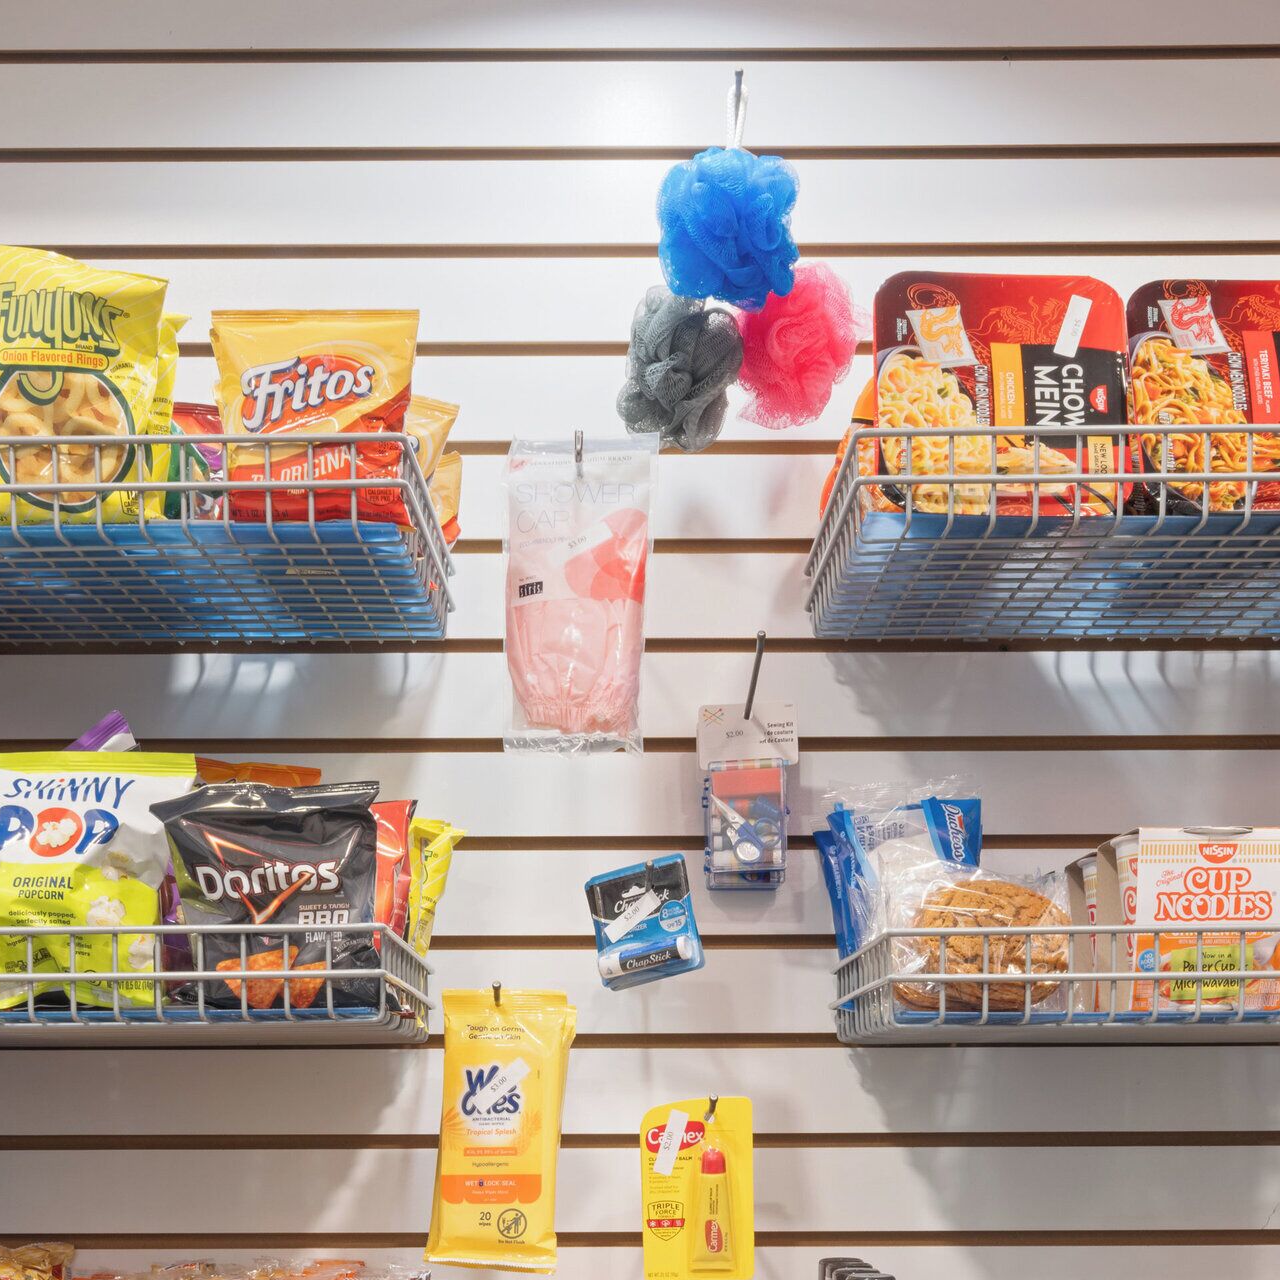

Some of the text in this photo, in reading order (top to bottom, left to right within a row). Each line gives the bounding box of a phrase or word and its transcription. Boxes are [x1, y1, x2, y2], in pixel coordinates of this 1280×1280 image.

[2, 349, 105, 368] Onion Flavored Rings
[242, 356, 376, 432] Fritos
[1033, 366, 1062, 427] MEIN
[1061, 364, 1086, 427] CHOW
[516, 483, 635, 505] SHOWER
[516, 509, 570, 534] CAP
[725, 729, 744, 739] $2.00
[942, 803, 967, 862] Duchess
[1201, 845, 1235, 857] NISSIN
[13, 876, 74, 890] ORIGINAL
[195, 861, 339, 901] Doritos
[1184, 866, 1252, 895] CUP
[18, 890, 64, 900] POPCORN
[623, 905, 641, 923] $2.00
[1154, 891, 1273, 921] NOODLES
[626, 950, 671, 970] ChapStick
[467, 1128, 517, 1137] Tropical Splash
[480, 1211, 492, 1221] 20
[652, 1202, 680, 1211] TRIPLE
[708, 1220, 720, 1253] Carmex
